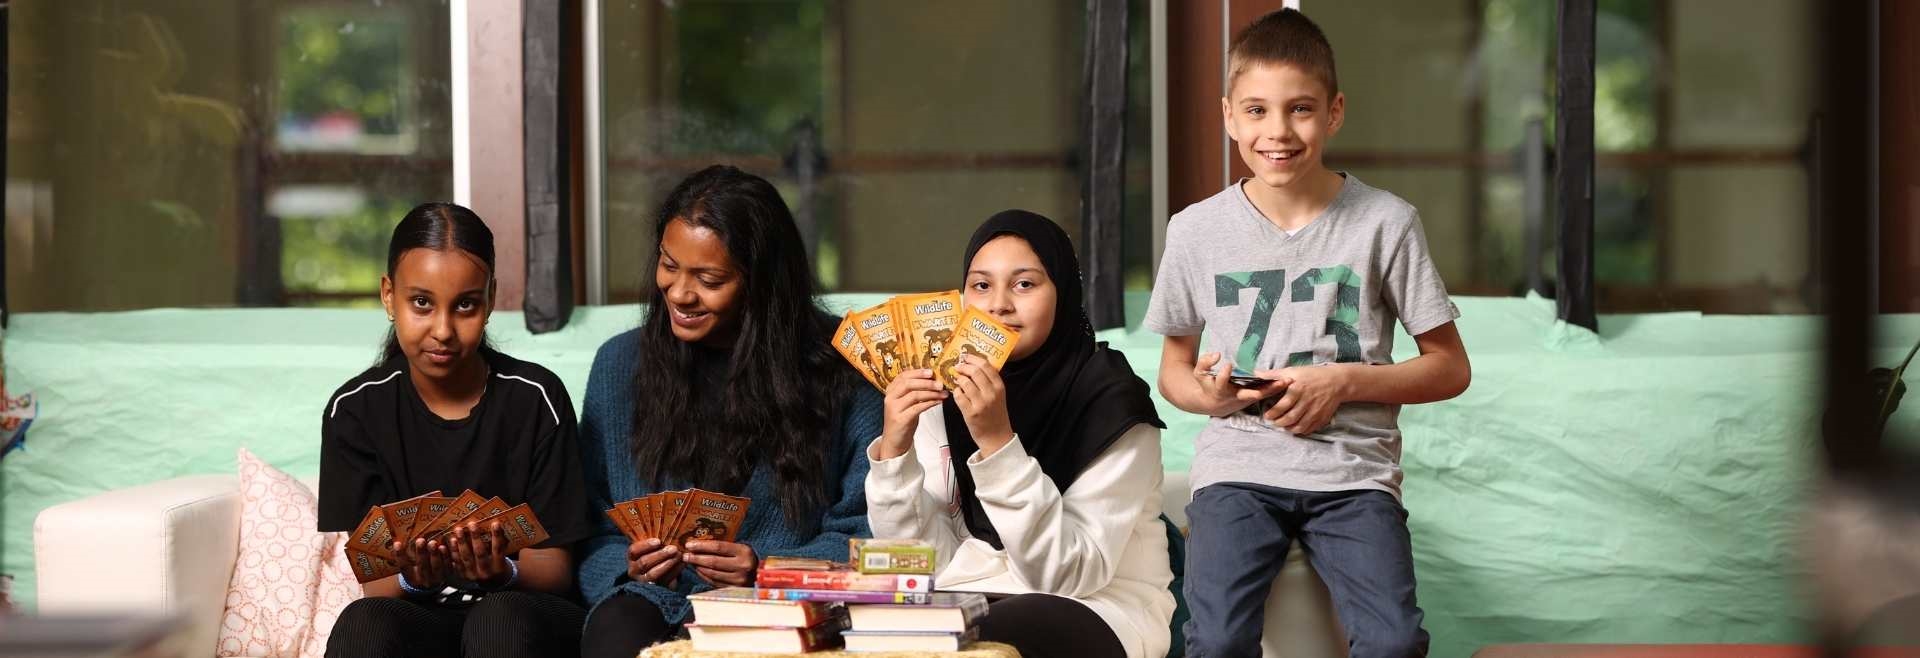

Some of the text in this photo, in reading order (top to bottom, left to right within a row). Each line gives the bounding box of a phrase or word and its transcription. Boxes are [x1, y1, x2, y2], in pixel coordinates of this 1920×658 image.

[914, 301, 953, 315] WildLife
[1215, 264, 1361, 373] 73
[971, 318, 1007, 345] WildLife
[701, 498, 738, 511] WildLife
